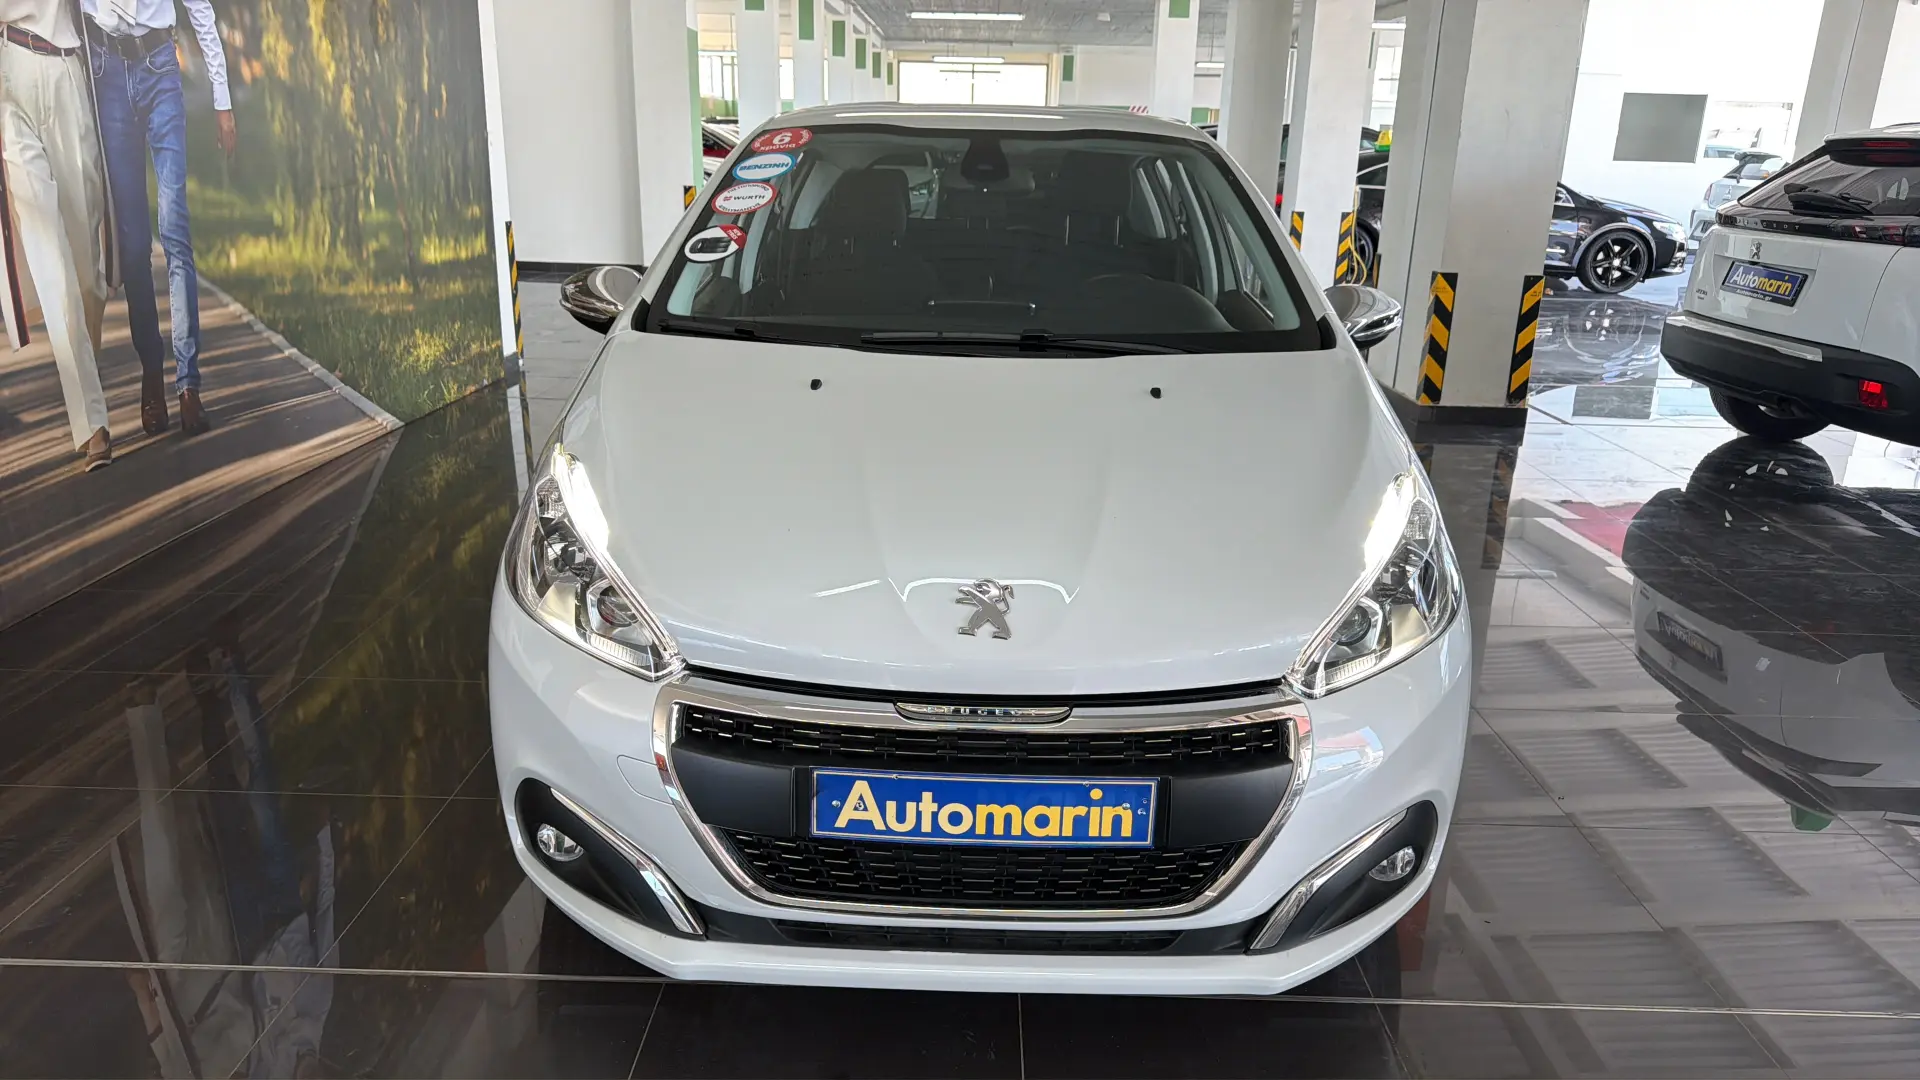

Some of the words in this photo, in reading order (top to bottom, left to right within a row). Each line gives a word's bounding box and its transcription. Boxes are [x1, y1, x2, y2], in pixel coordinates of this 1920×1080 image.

[772, 132, 792, 145] 6
[1730, 266, 1792, 295] Automarin
[834, 780, 1133, 837] Automarin
